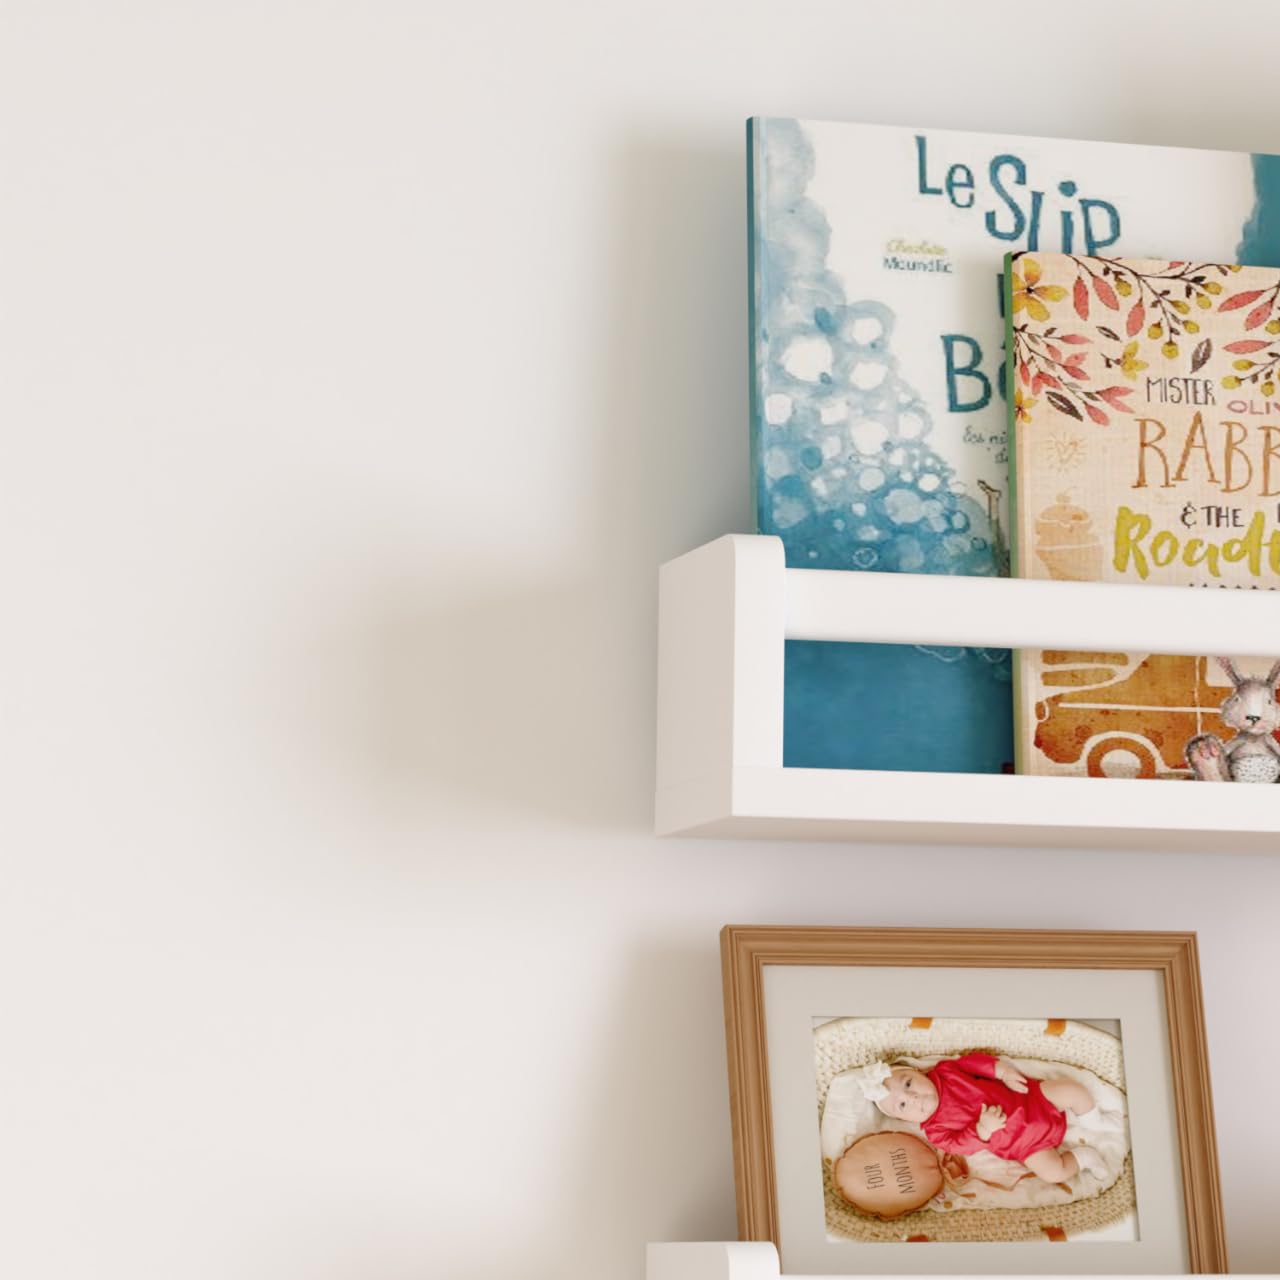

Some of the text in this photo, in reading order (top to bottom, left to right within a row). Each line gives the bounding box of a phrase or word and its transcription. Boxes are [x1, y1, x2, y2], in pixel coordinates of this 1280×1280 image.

[915, 135, 1121, 257] Le Slip
[1146, 376, 1216, 405] MISTER
[1201, 505, 1245, 528] THE
[863, 1163, 885, 1190] FOUR
[889, 1148, 916, 1194] MONTHS
